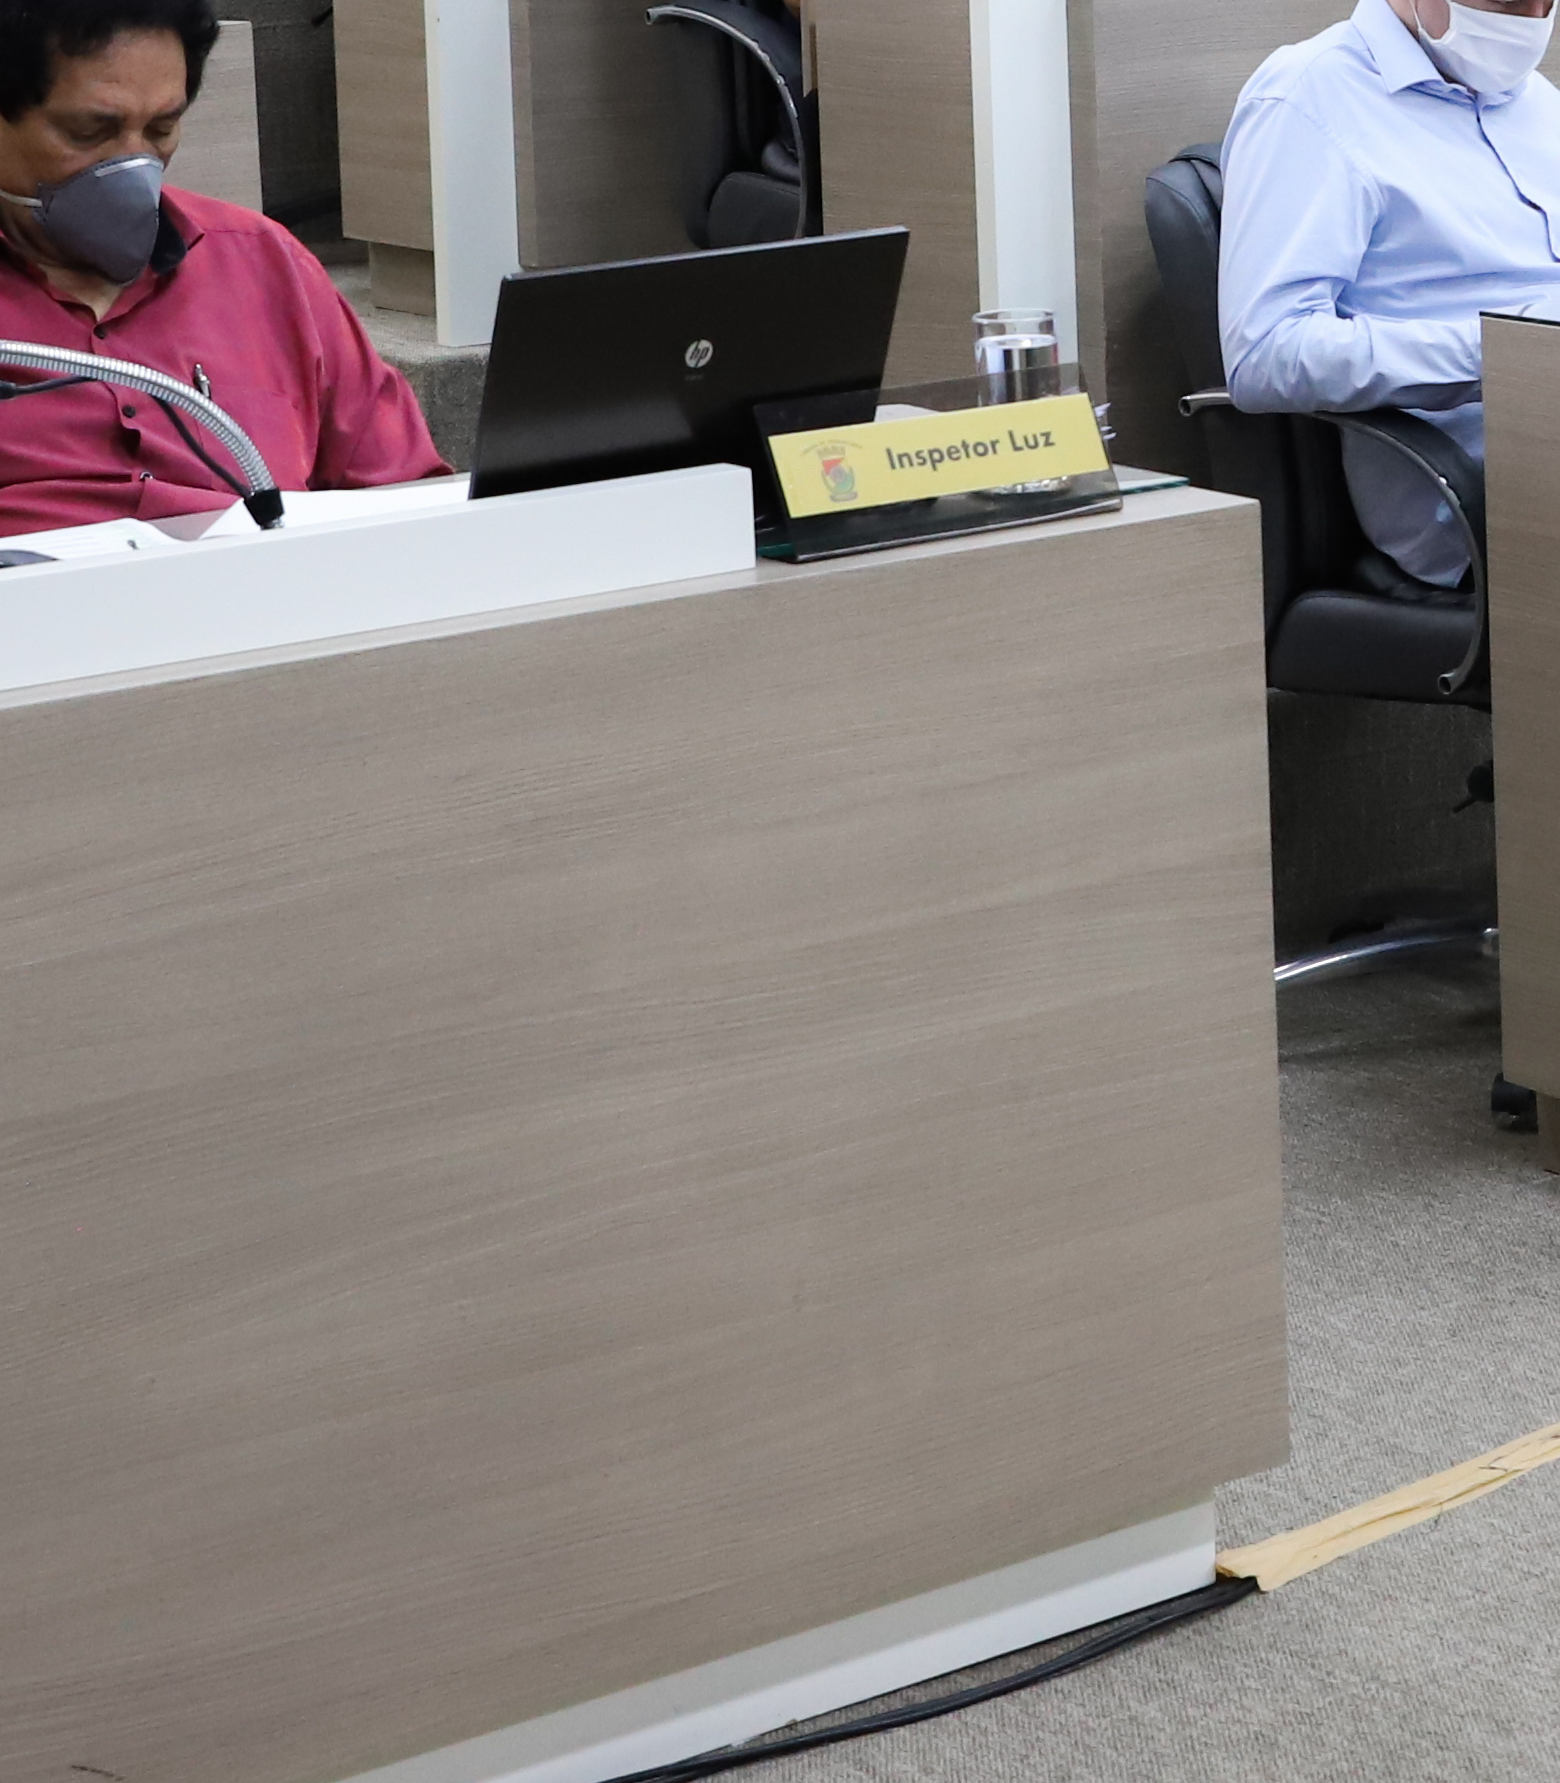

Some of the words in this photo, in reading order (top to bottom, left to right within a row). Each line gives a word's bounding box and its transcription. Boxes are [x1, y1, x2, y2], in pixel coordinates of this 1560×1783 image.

[686, 339, 712, 368] hp
[886, 437, 1000, 471] Inspetor
[1007, 429, 1055, 452] Luz
